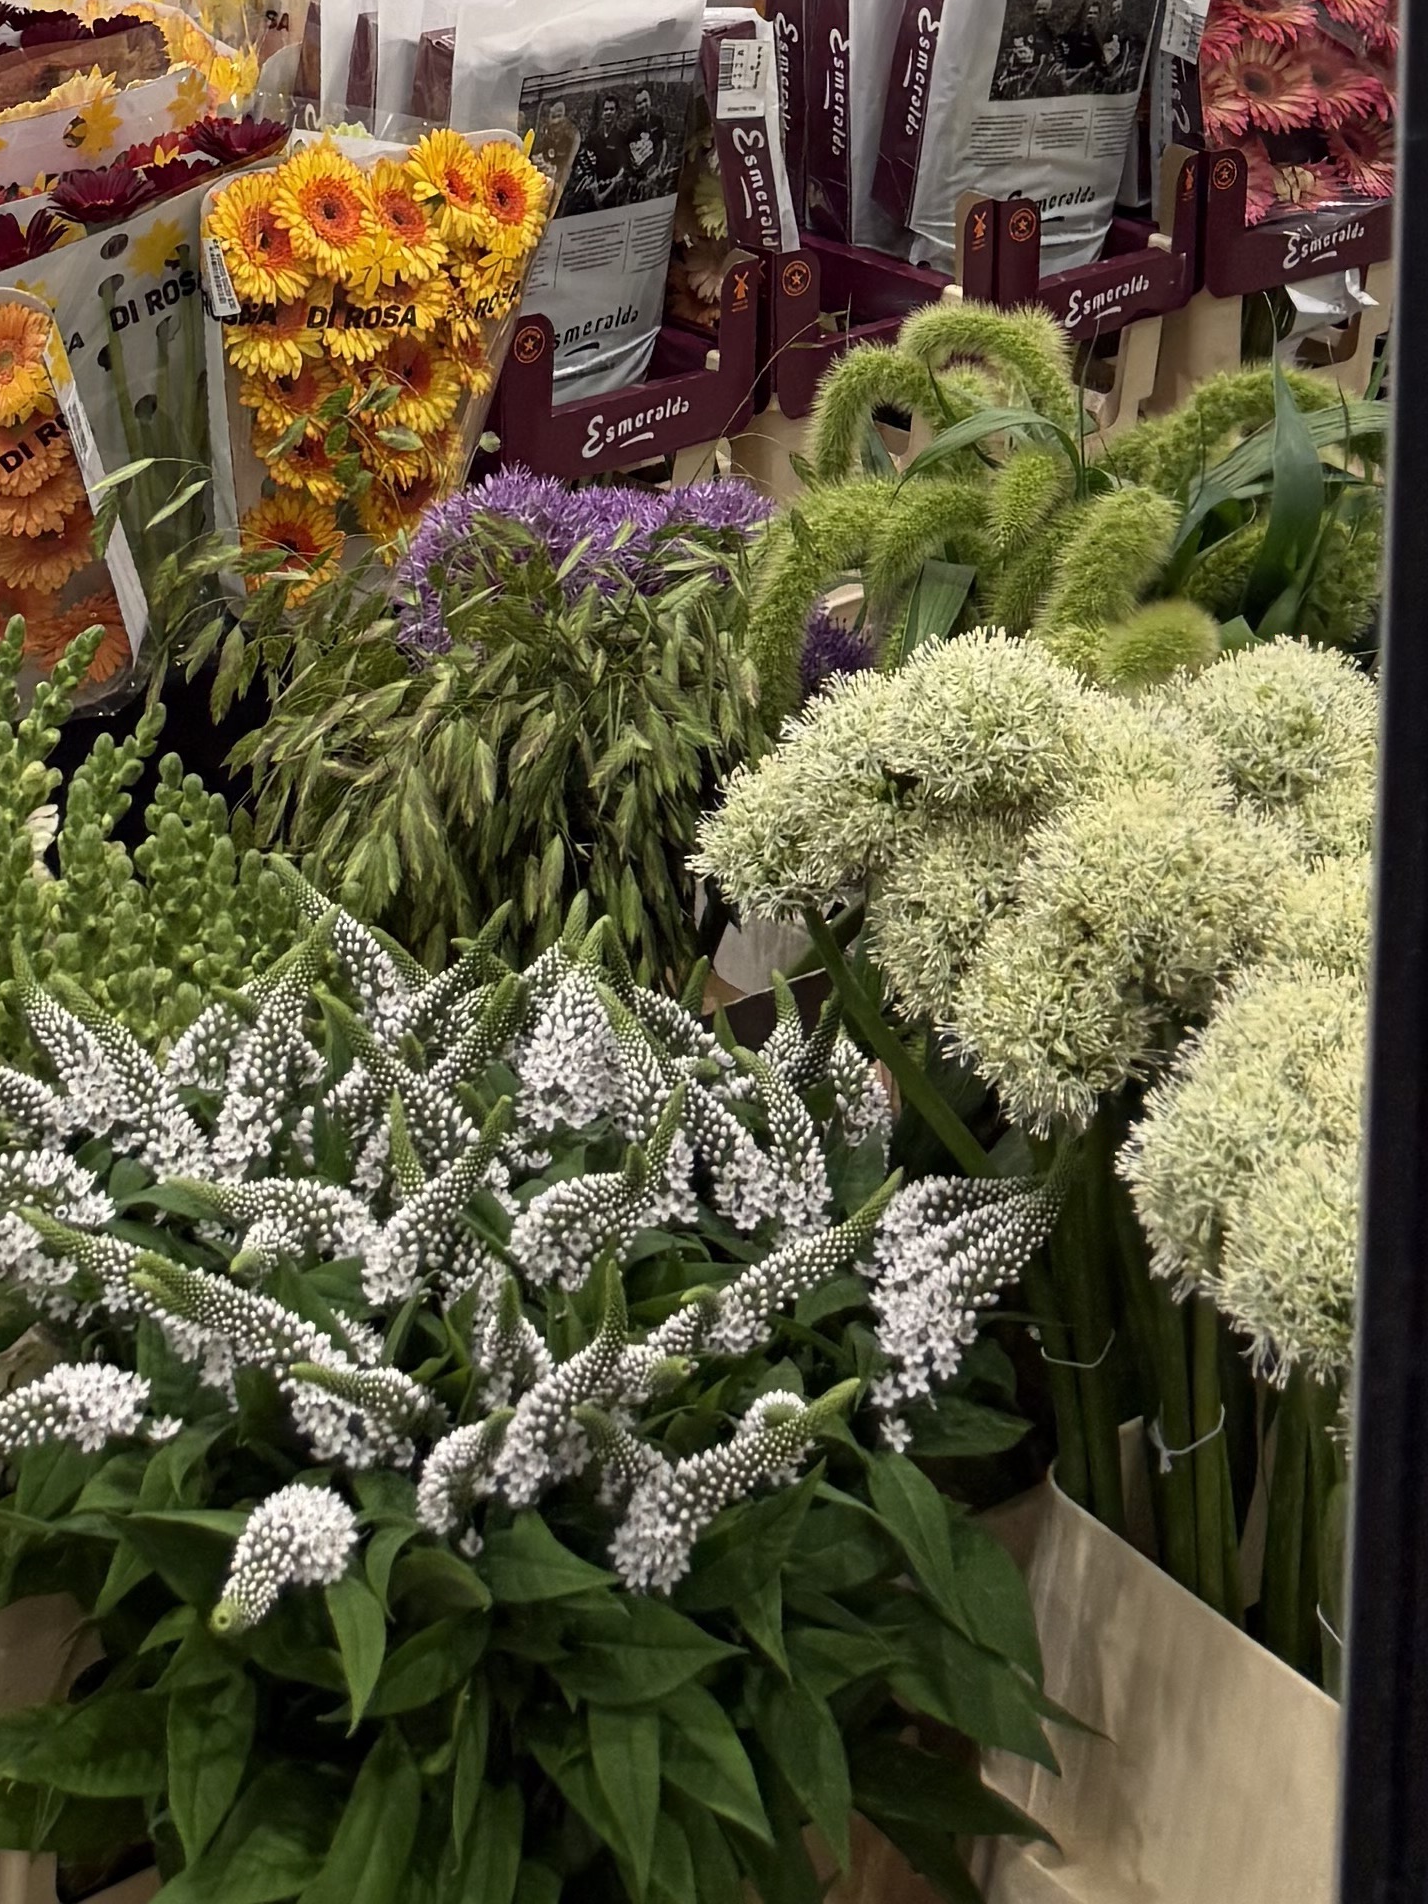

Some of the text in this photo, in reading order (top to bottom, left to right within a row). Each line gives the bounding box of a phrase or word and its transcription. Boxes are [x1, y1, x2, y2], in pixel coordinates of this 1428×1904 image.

[829, 28, 851, 156] Esmeralda
[904, 6, 941, 136] Esmeralda
[731, 126, 780, 249] Esmerald
[108, 299, 140, 333] DI
[342, 303, 418, 331] ROSA
[553, 304, 639, 350] smeralda
[1063, 273, 1151, 329] Esmeralda
[581, 395, 691, 459] Esmeralda
